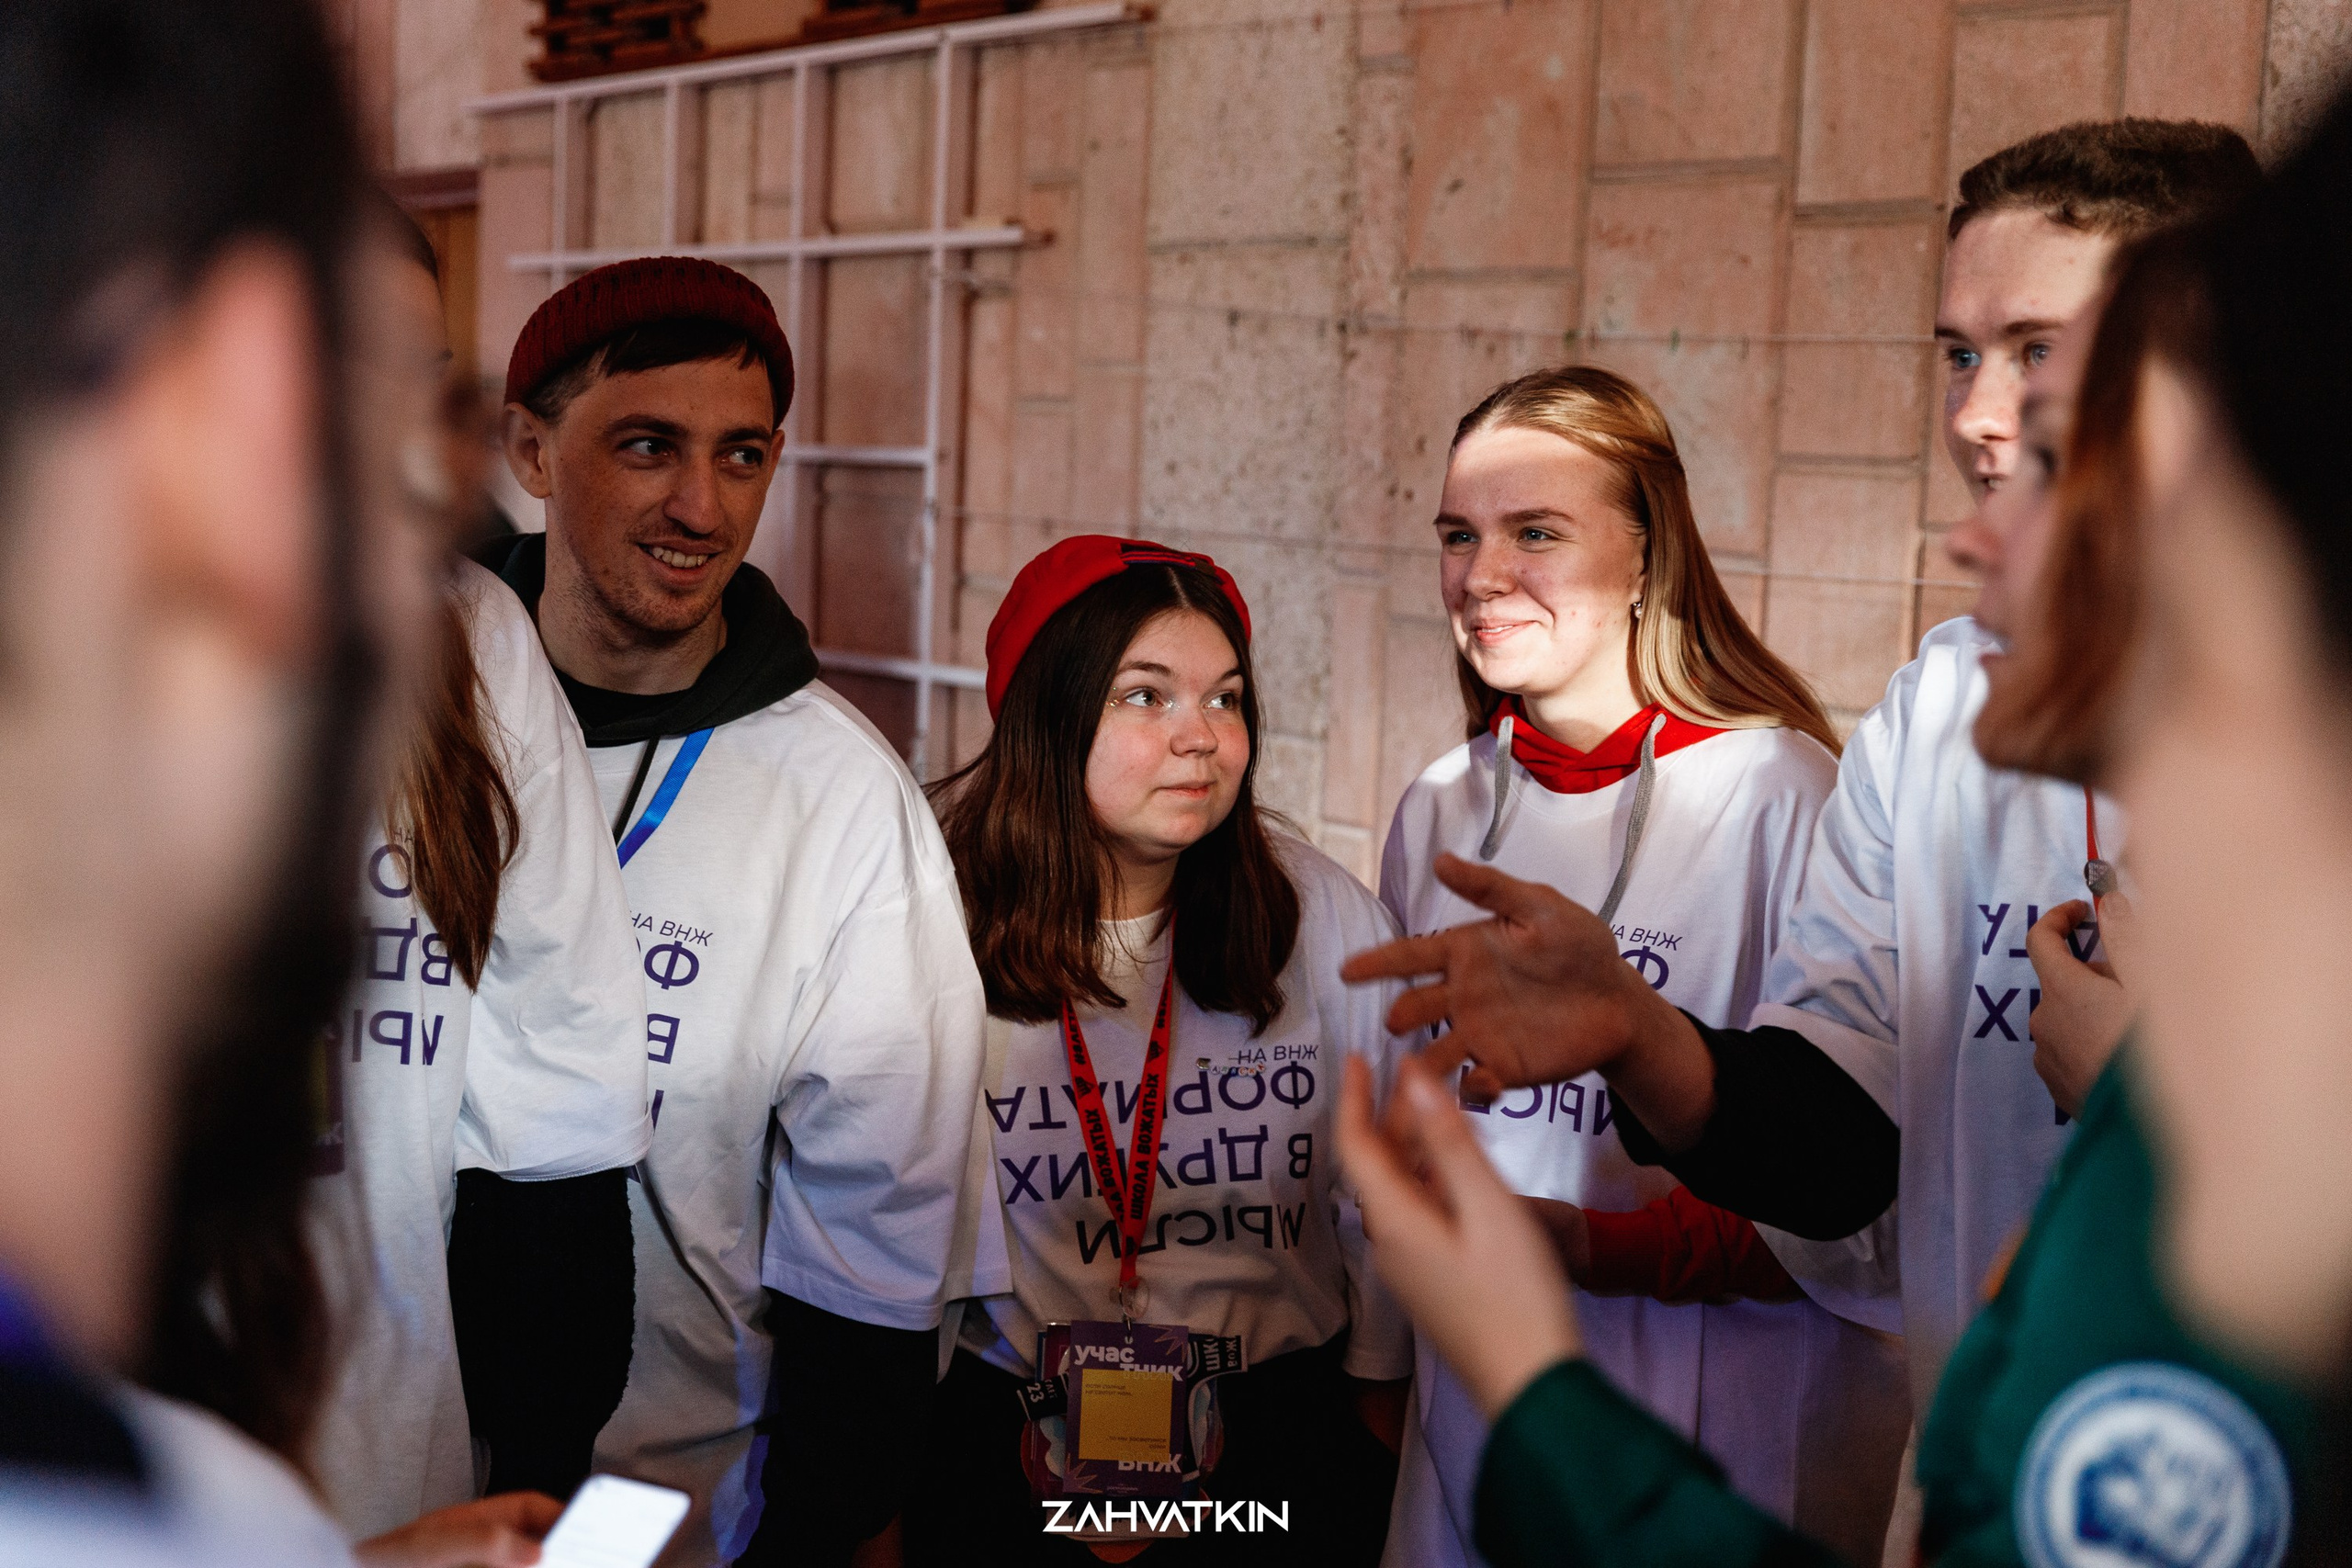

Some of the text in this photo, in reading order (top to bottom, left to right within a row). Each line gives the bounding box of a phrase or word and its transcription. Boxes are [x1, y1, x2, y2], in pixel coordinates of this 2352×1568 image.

[660, 920, 714, 947] ВНЖ
[1629, 927, 1683, 952] ВНЖ
[1238, 1044, 1319, 1065] НА ВНЖ
[1136, 1073, 1159, 1154] ВОЖАТЫХ
[1084, 1108, 1114, 1189] ВОЖАТЫХ
[1287, 1132, 1314, 1179] В
[1129, 1155, 1151, 1220] ШКОЛА
[1072, 1344, 1136, 1366] учас
[1026, 1382, 1045, 1403] 23
